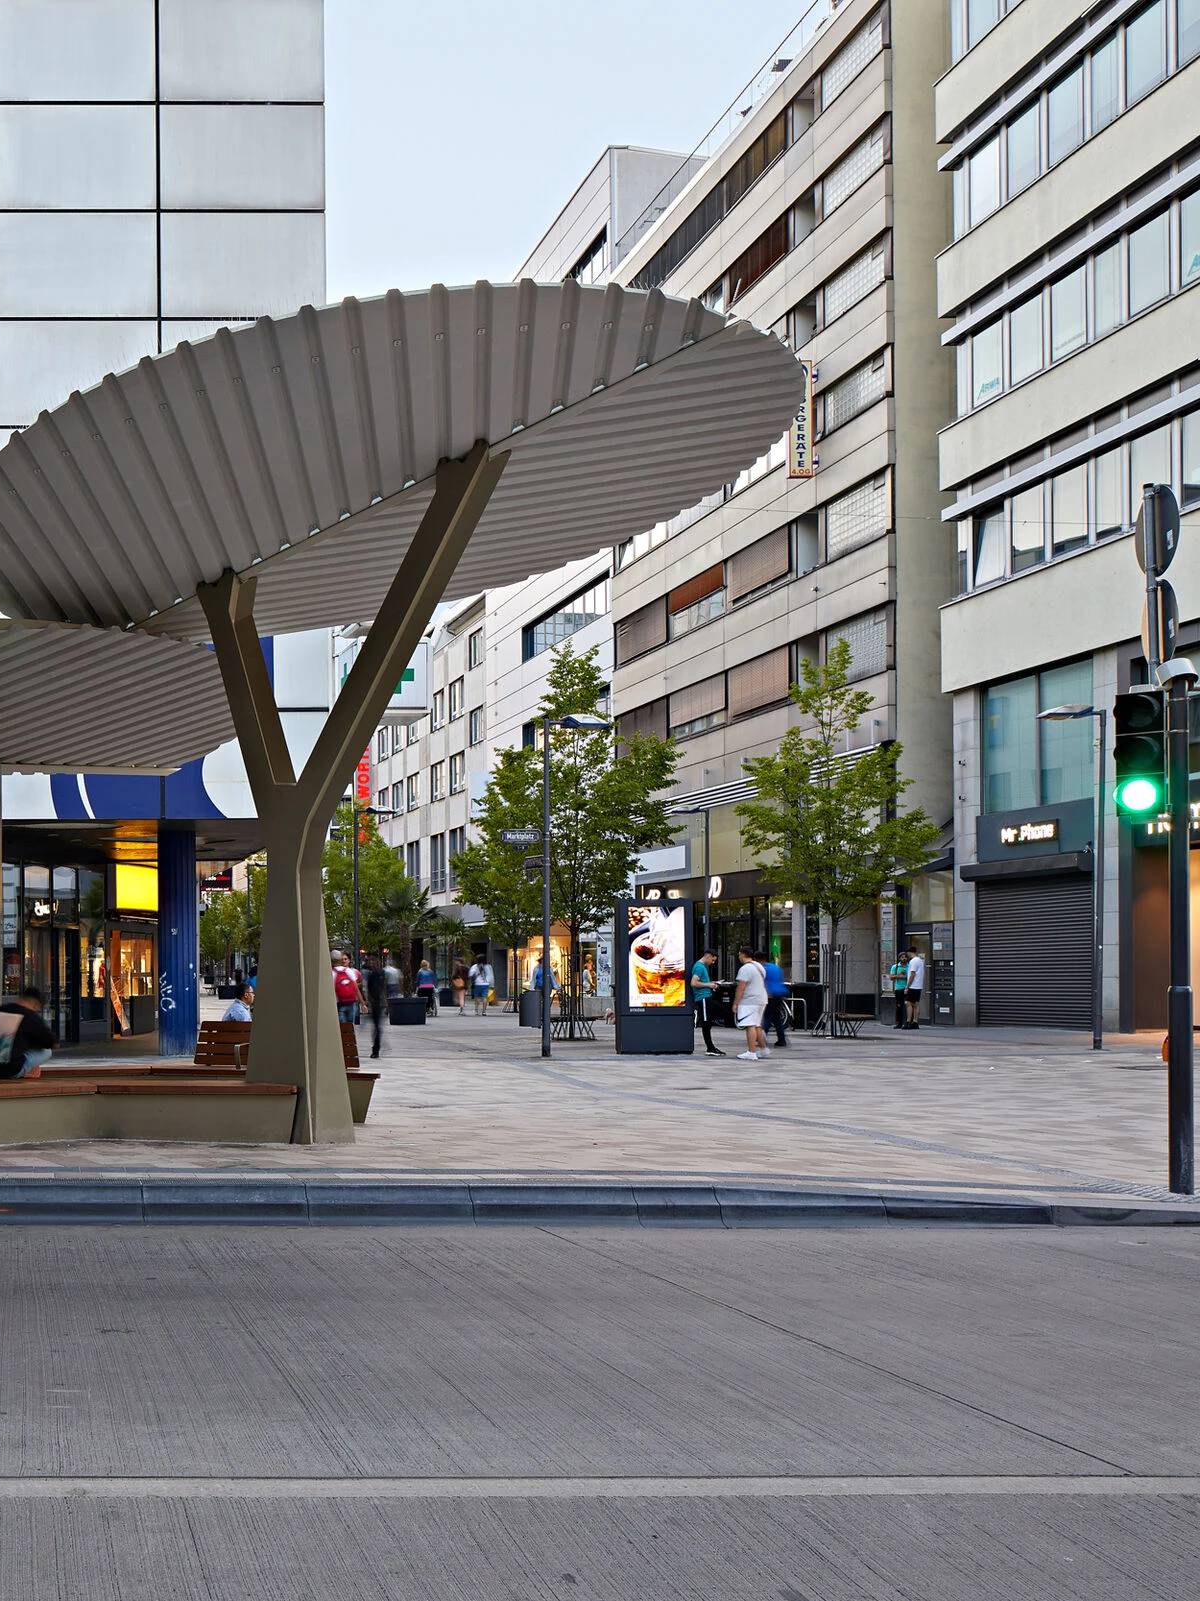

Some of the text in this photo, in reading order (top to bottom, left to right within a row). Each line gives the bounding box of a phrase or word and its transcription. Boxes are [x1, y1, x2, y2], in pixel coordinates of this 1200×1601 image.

[795, 398, 806, 468] RGERÄTE
[506, 832, 535, 841] Marktplatz
[708, 876, 722, 899] JD
